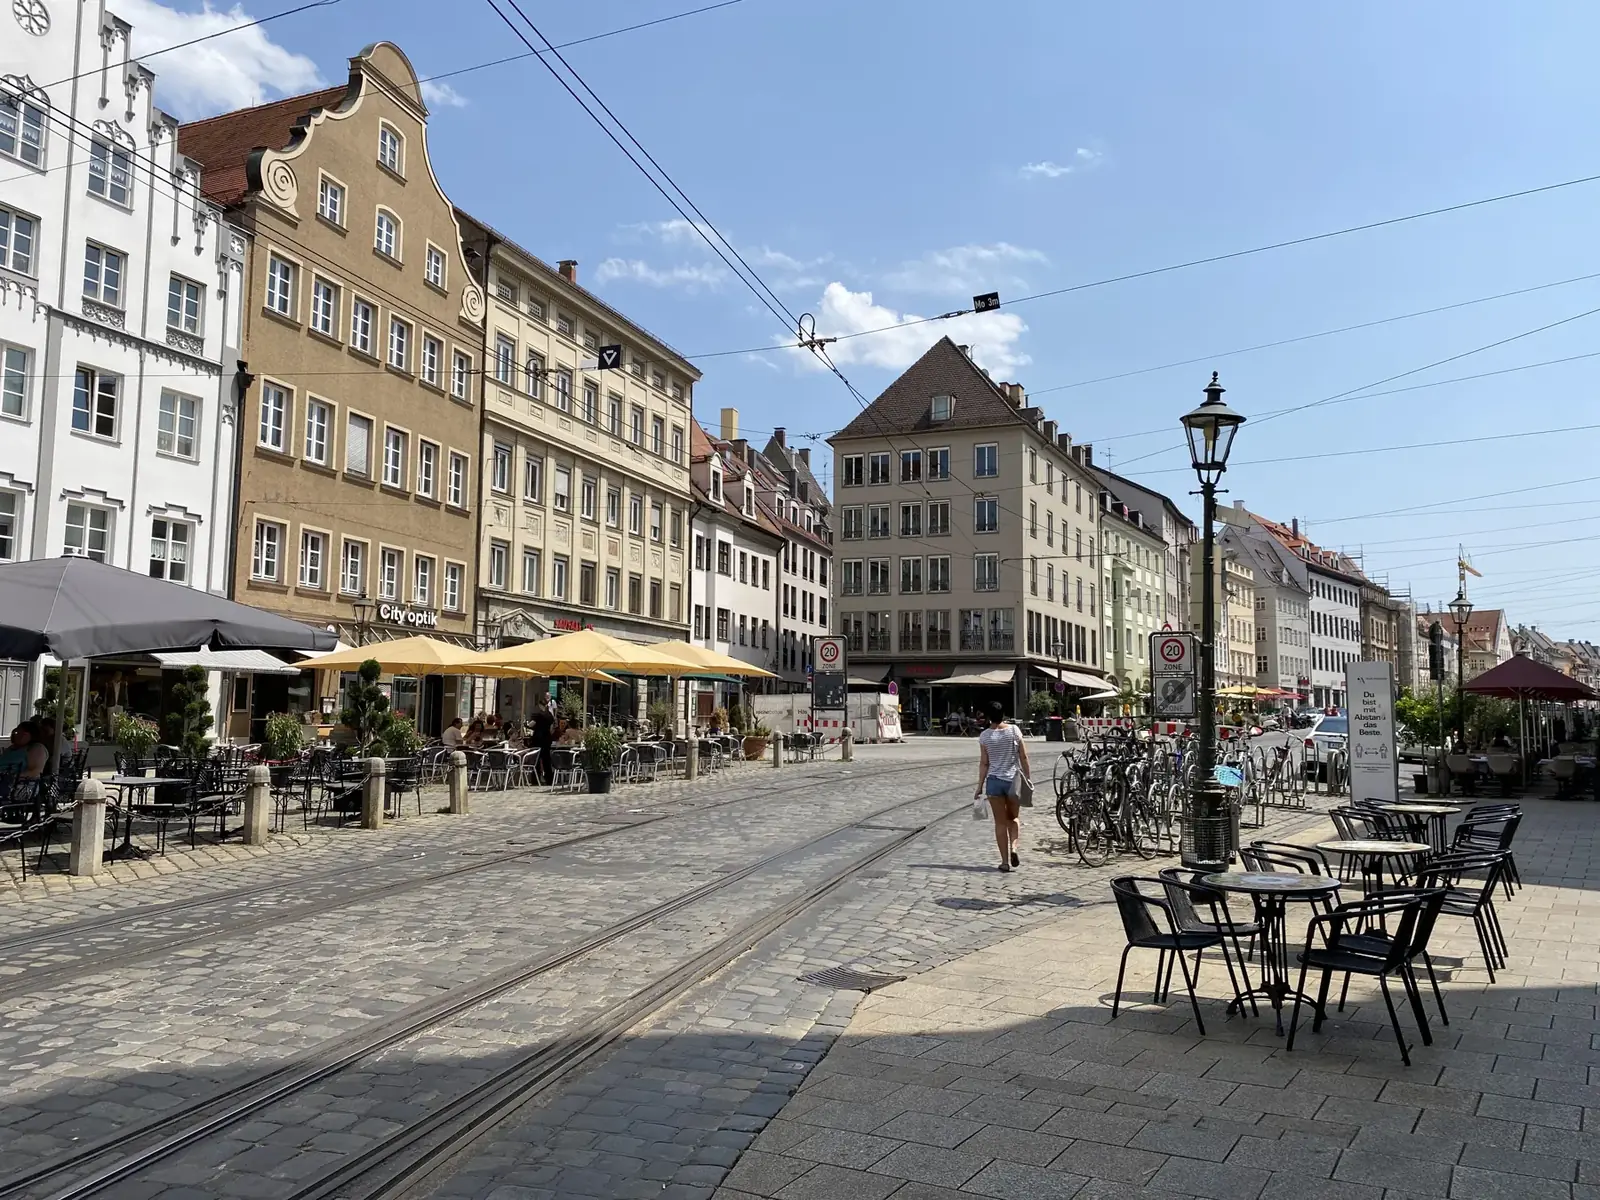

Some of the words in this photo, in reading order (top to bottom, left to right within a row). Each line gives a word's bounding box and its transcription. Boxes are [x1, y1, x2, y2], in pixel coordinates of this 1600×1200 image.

[987, 297, 998, 306] 3m
[380, 603, 405, 624] City
[408, 610, 438, 626] optik
[824, 647, 835, 657] 20
[1166, 645, 1180, 656] 20
